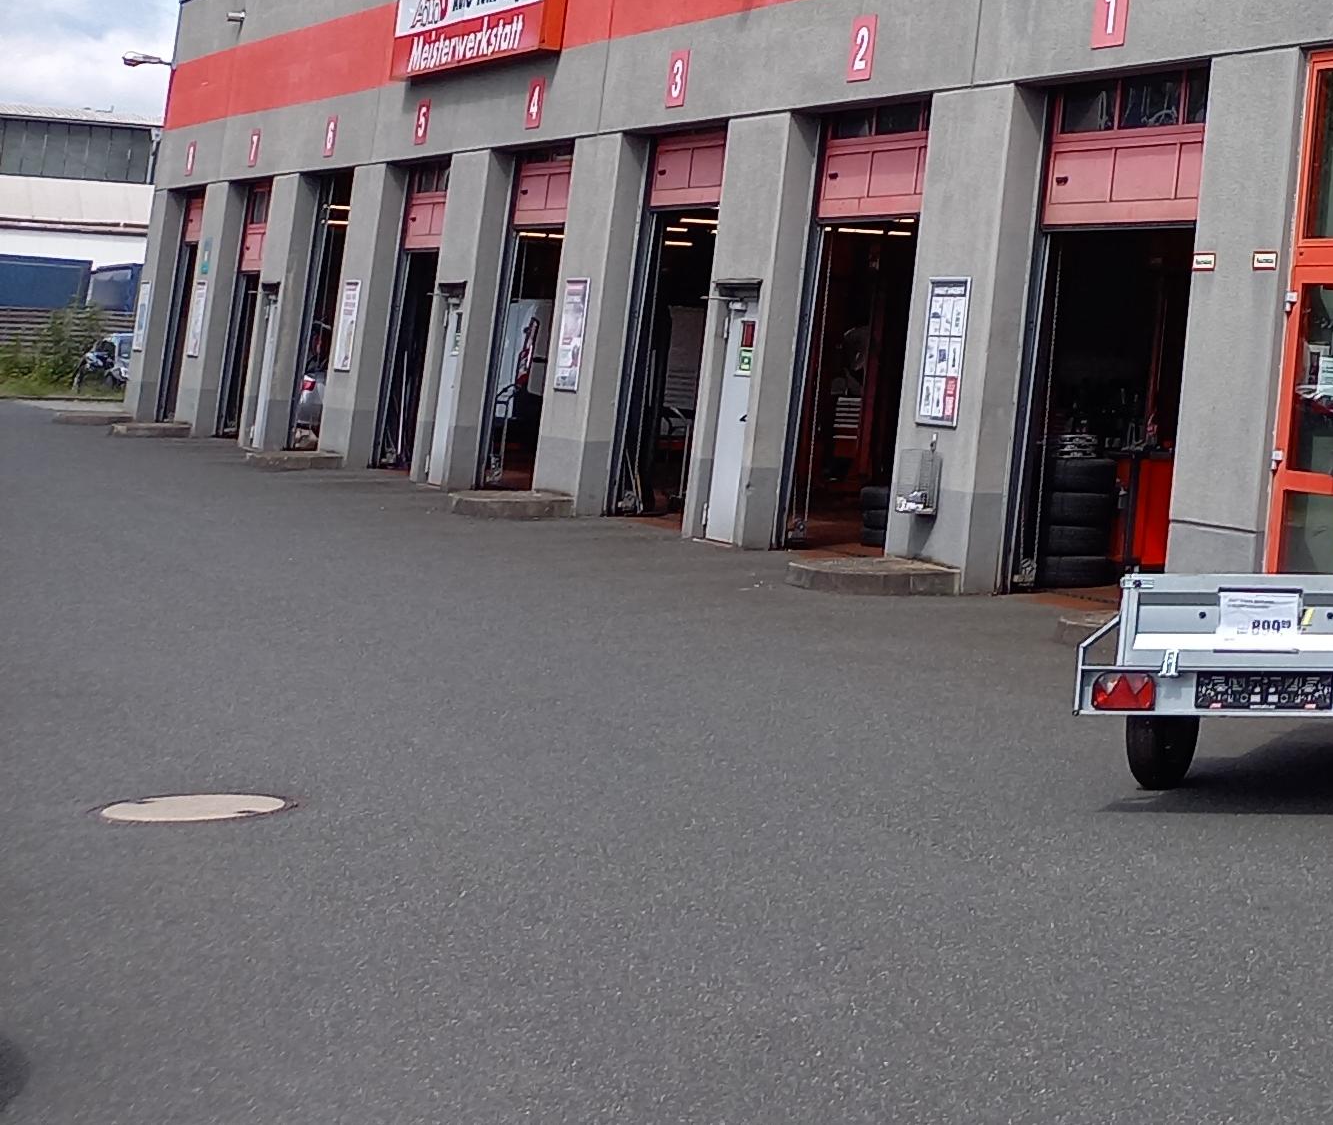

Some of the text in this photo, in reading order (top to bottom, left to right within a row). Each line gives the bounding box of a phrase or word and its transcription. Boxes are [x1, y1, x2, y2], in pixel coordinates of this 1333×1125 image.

[407, 14, 524, 73] Meisterwerkstatt
[852, 26, 870, 71] 2
[671, 59, 684, 98] 3
[529, 85, 541, 119] 4
[326, 121, 336, 151] 6
[416, 106, 428, 138] 5
[250, 134, 259, 162] 7
